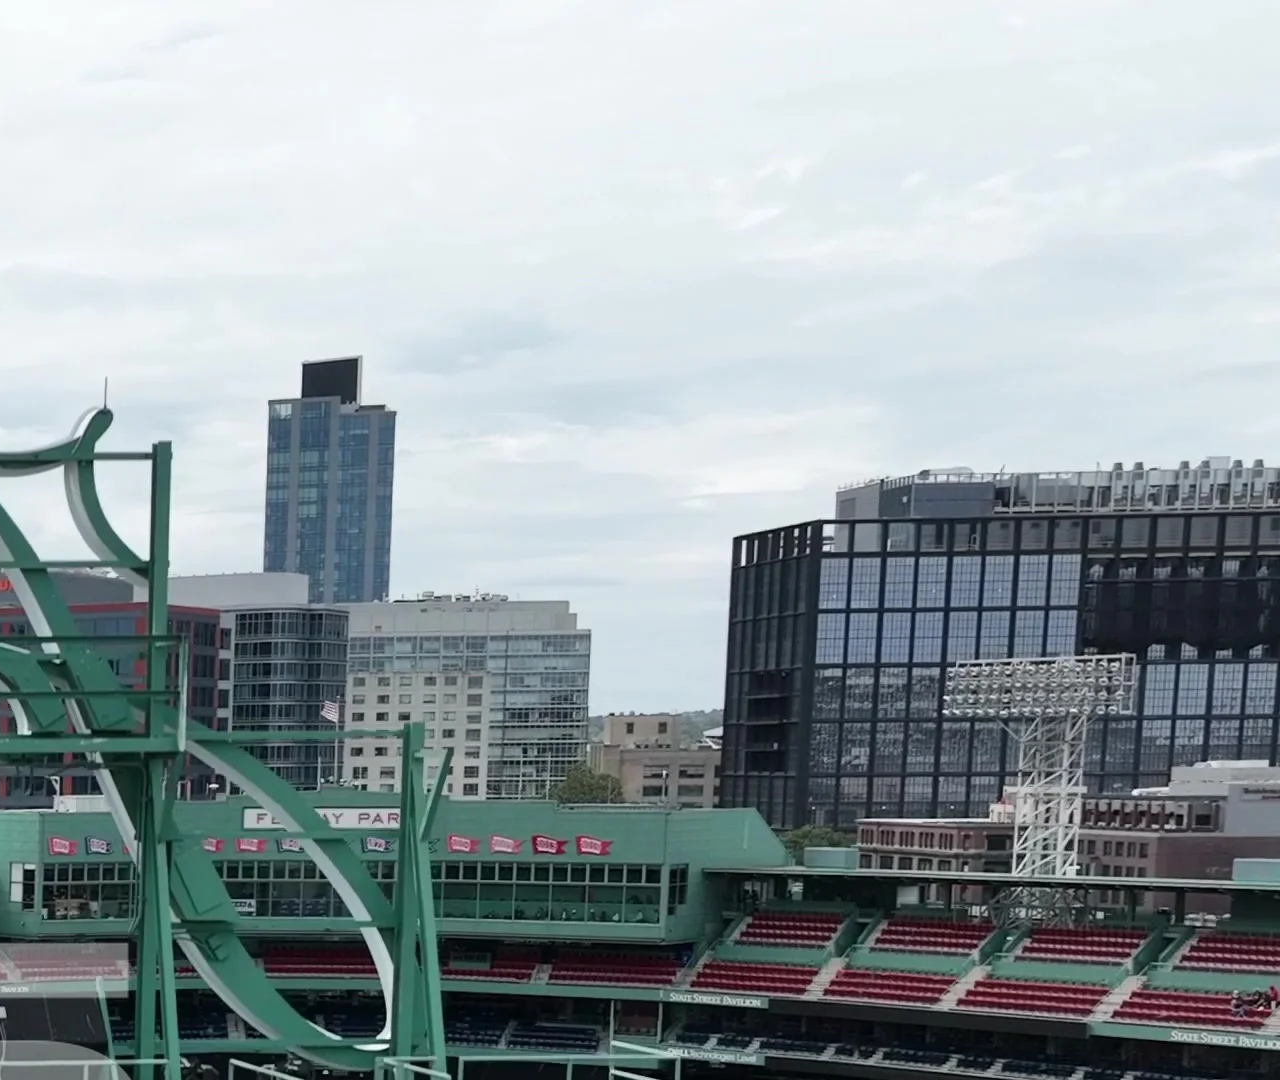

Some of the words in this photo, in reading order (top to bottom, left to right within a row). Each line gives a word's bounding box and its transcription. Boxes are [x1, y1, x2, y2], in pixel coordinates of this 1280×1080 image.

[358, 813, 400, 824] PAR
[669, 992, 691, 1001] STATE
[693, 993, 720, 1003] STREET
[723, 995, 761, 1007] PAVILION
[1171, 1030, 1199, 1042] STATE
[1201, 1032, 1237, 1045] STREET
[1240, 1036, 1280, 1050] PAVILIO
